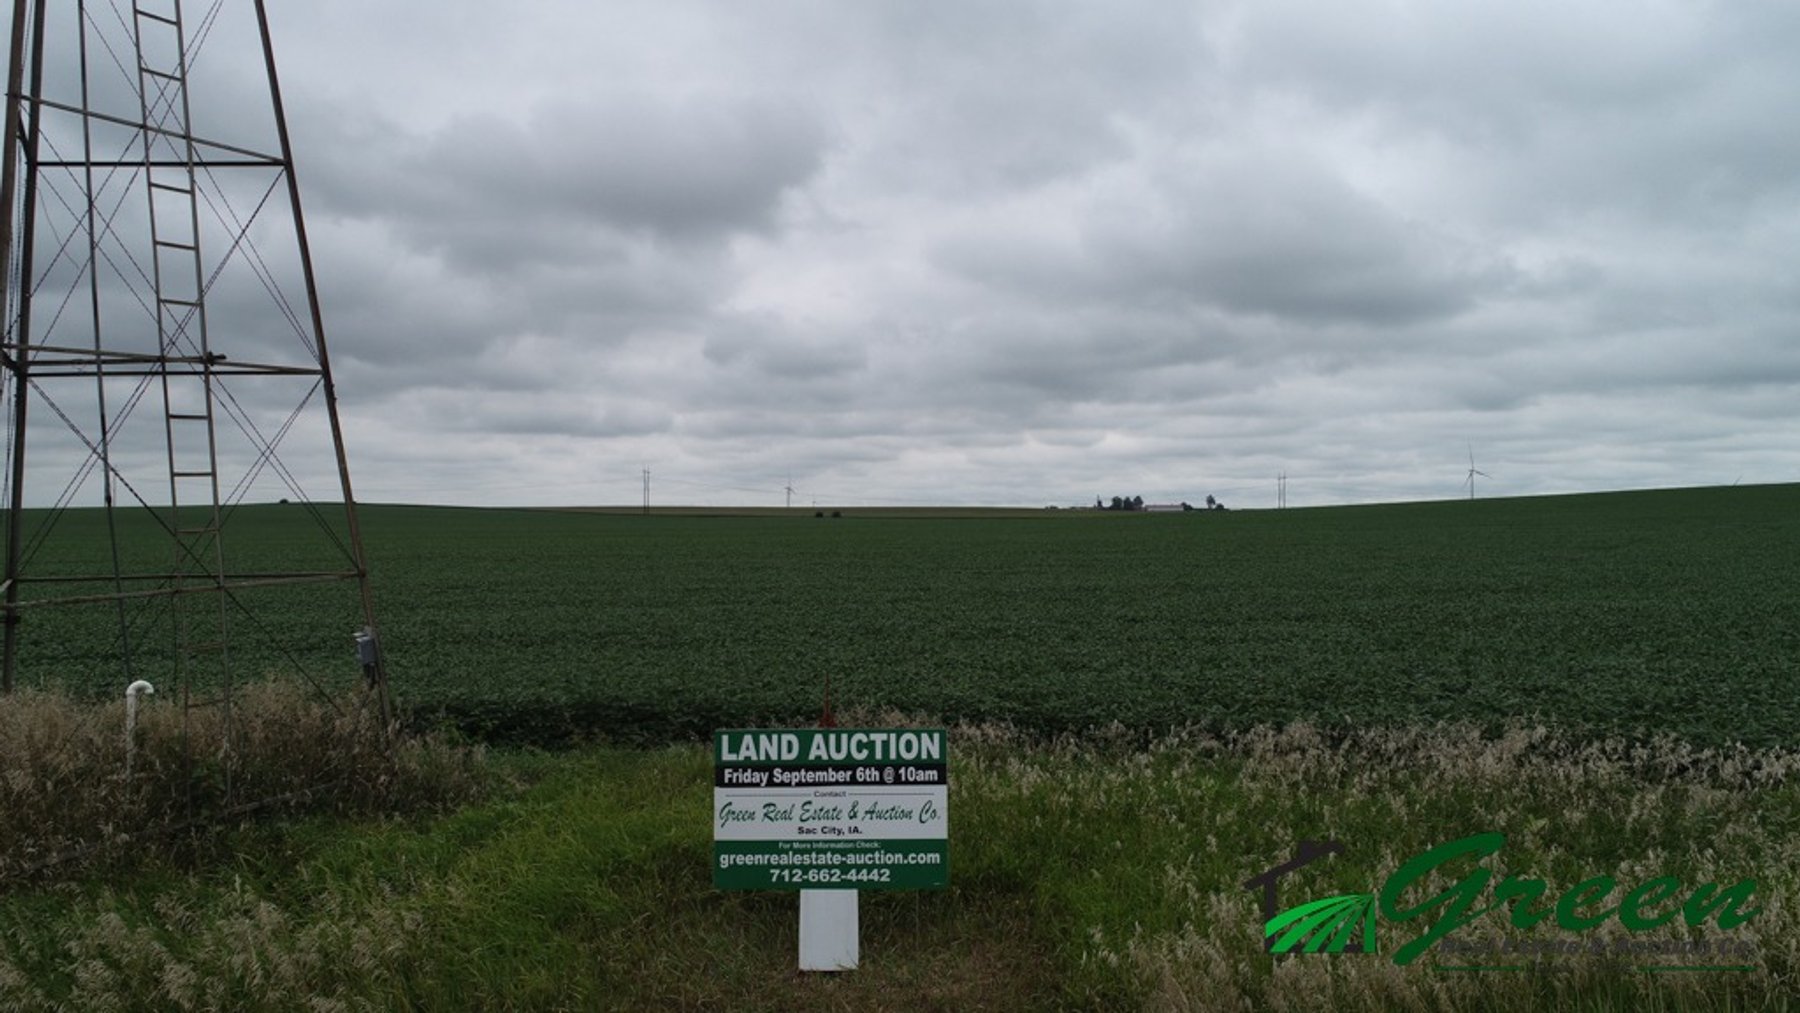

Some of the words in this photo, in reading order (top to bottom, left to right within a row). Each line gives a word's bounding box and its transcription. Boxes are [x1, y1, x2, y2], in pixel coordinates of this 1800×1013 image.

[721, 734, 799, 760] LAND
[809, 733, 940, 760] AUCTION
[724, 768, 768, 786] Friday
[773, 767, 852, 786] September
[856, 766, 880, 782] 6th
[883, 767, 895, 783] @
[899, 767, 938, 782] 10am
[720, 802, 756, 827] Green
[762, 803, 795, 822] Real
[800, 801, 842, 822] Estate
[848, 801, 858, 820] &
[862, 801, 913, 821] Auction
[919, 800, 941, 823] Co.
[821, 827, 844, 836] City,
[720, 850, 940, 868] greenrealestate-auction.com
[770, 869, 890, 882] 712-662-4442
